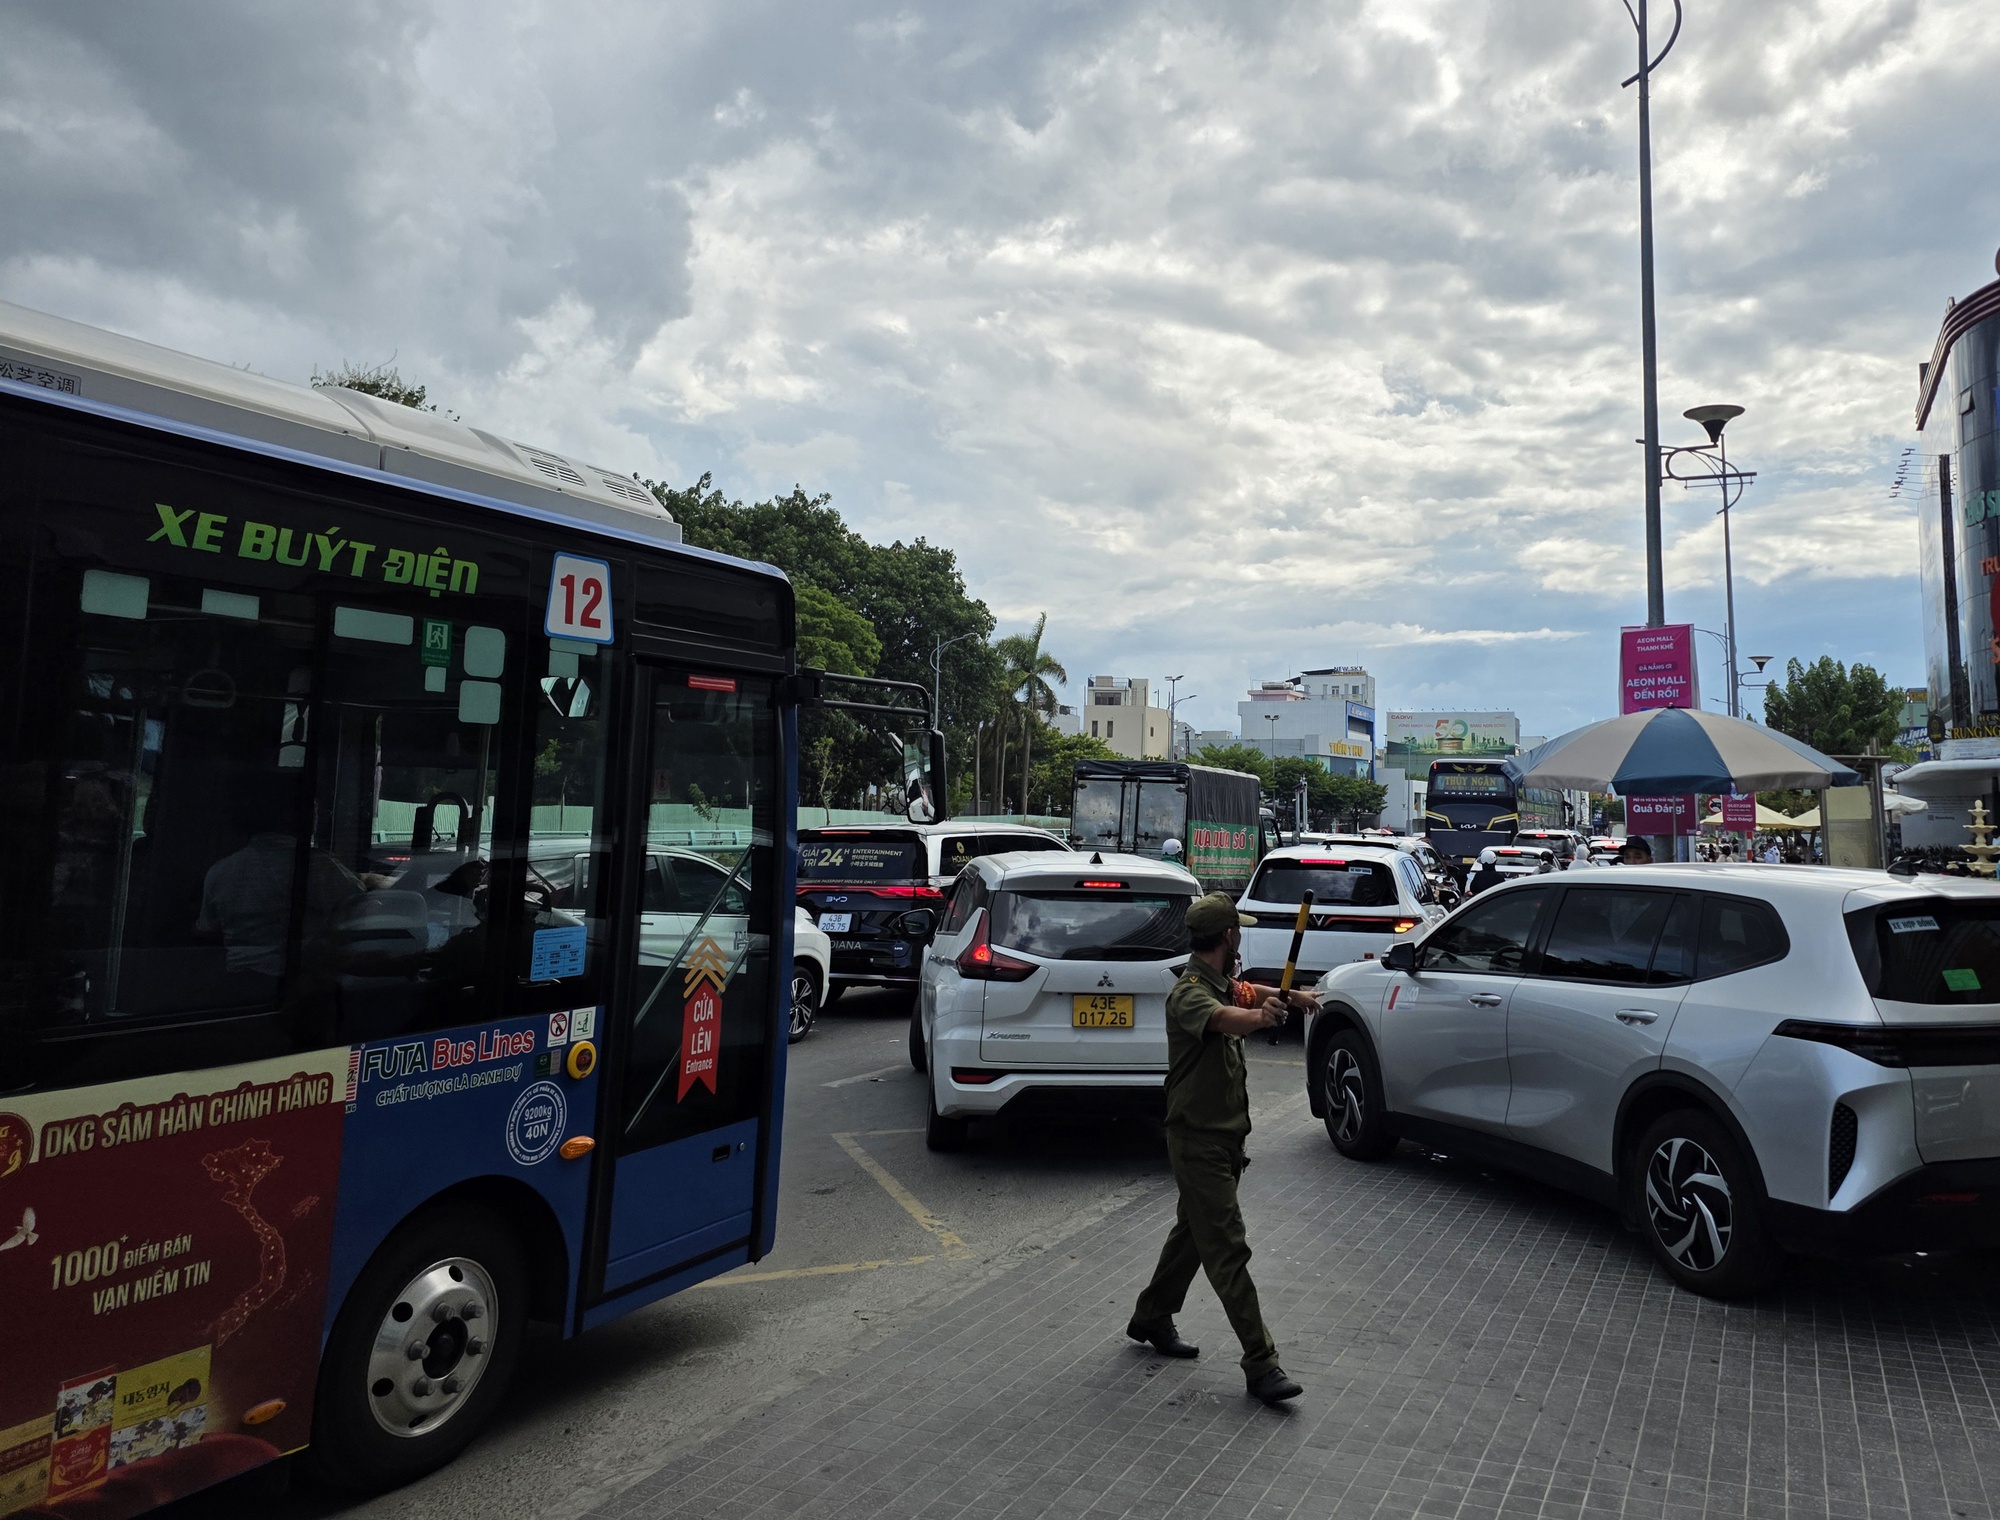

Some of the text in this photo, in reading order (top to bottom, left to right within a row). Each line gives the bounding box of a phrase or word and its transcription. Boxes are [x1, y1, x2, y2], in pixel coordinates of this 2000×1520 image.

[146, 502, 229, 553] XE
[238, 520, 376, 578] BUÝT
[559, 574, 602, 628] 12
[1626, 675, 1686, 688] AEON MALL
[1633, 685, 1679, 700] ĐẾN RỒI!
[1435, 719, 1469, 739] 50
[1949, 726, 1982, 739] TRUNG
[1329, 738, 1363, 757] TIẾN THU
[1444, 773, 1496, 786] THỦY NGÂN
[1633, 804, 1652, 814] Quá
[1232, 827, 1247, 850] SỐ
[1248, 833, 1254, 851] 1
[802, 846, 820, 858] GIẢI
[817, 847, 843, 867] 24
[852, 848, 903, 857] ENTERTAINMENT
[825, 895, 848, 903] BYD
[821, 922, 847, 931] 205.75
[828, 914, 843, 923] 43B
[1891, 921, 1902, 930] XE
[693, 992, 714, 1023] CỬA
[1090, 996, 1117, 1010] 43E
[1080, 1011, 1127, 1026] 017.26
[690, 1026, 712, 1056] LÊN
[362, 1029, 536, 1083] FUTA Bus Lines
[685, 1058, 713, 1075] Entrance
[375, 1083, 411, 1107] CHẤT
[410, 1078, 453, 1102] LƯỢNG
[454, 1072, 469, 1090] LÀ
[470, 1068, 503, 1089] DANH
[503, 1062, 523, 1083] DỰ
[45, 1077, 331, 1159] DKG SÂM HÀN CHÍNH HÃNG
[524, 1104, 553, 1121] 9200kg
[525, 1122, 549, 1140] 40N
[123, 1238, 161, 1270] ĐIỂM
[163, 1233, 193, 1259] BÁN
[92, 1260, 212, 1315] VẠN NIỀM TIN
